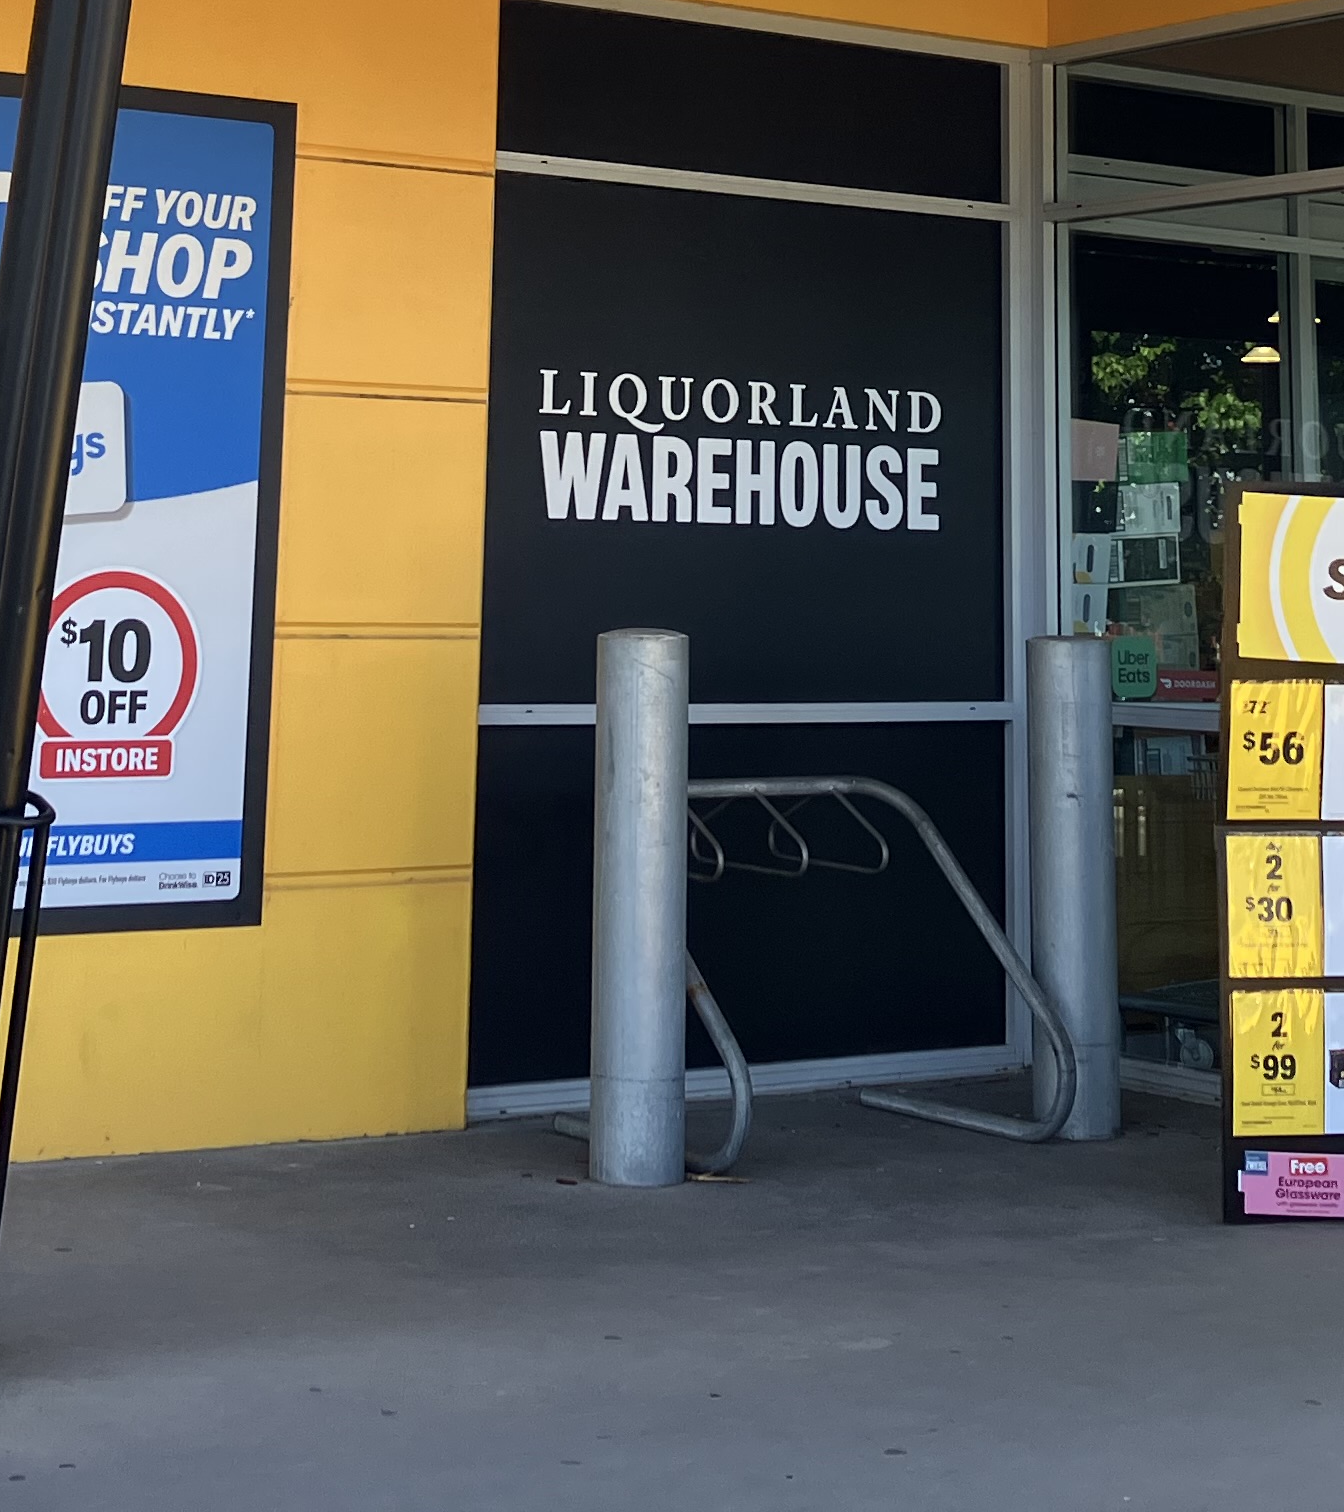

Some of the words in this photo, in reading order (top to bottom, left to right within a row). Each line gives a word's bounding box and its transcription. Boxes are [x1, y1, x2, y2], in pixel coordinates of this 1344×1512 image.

[102, 184, 148, 222] FF
[154, 188, 258, 232] YOUR
[538, 368, 942, 433] LIQUORLAND
[539, 430, 940, 531] WAREHOUSE
[60, 617, 152, 684] $10
[1118, 650, 1149, 666] Uber
[1118, 668, 1150, 684] Eats
[1174, 678, 1216, 689] DOORDASH
[80, 690, 148, 725] OFF
[55, 747, 159, 774] INSTORE
[1243, 729, 1305, 766] $56
[46, 833, 136, 858] FLYBUYS
[159, 872, 186, 881] Choose
[188, 872, 196, 880] to
[1266, 854, 1283, 880] 2
[1245, 896, 1293, 923] $30
[1270, 1011, 1288, 1038] 2
[1250, 1053, 1297, 1081] $99
[1291, 1159, 1326, 1174] Free
[1275, 1188, 1341, 1200] Glassware
[1278, 1176, 1339, 1189] European
